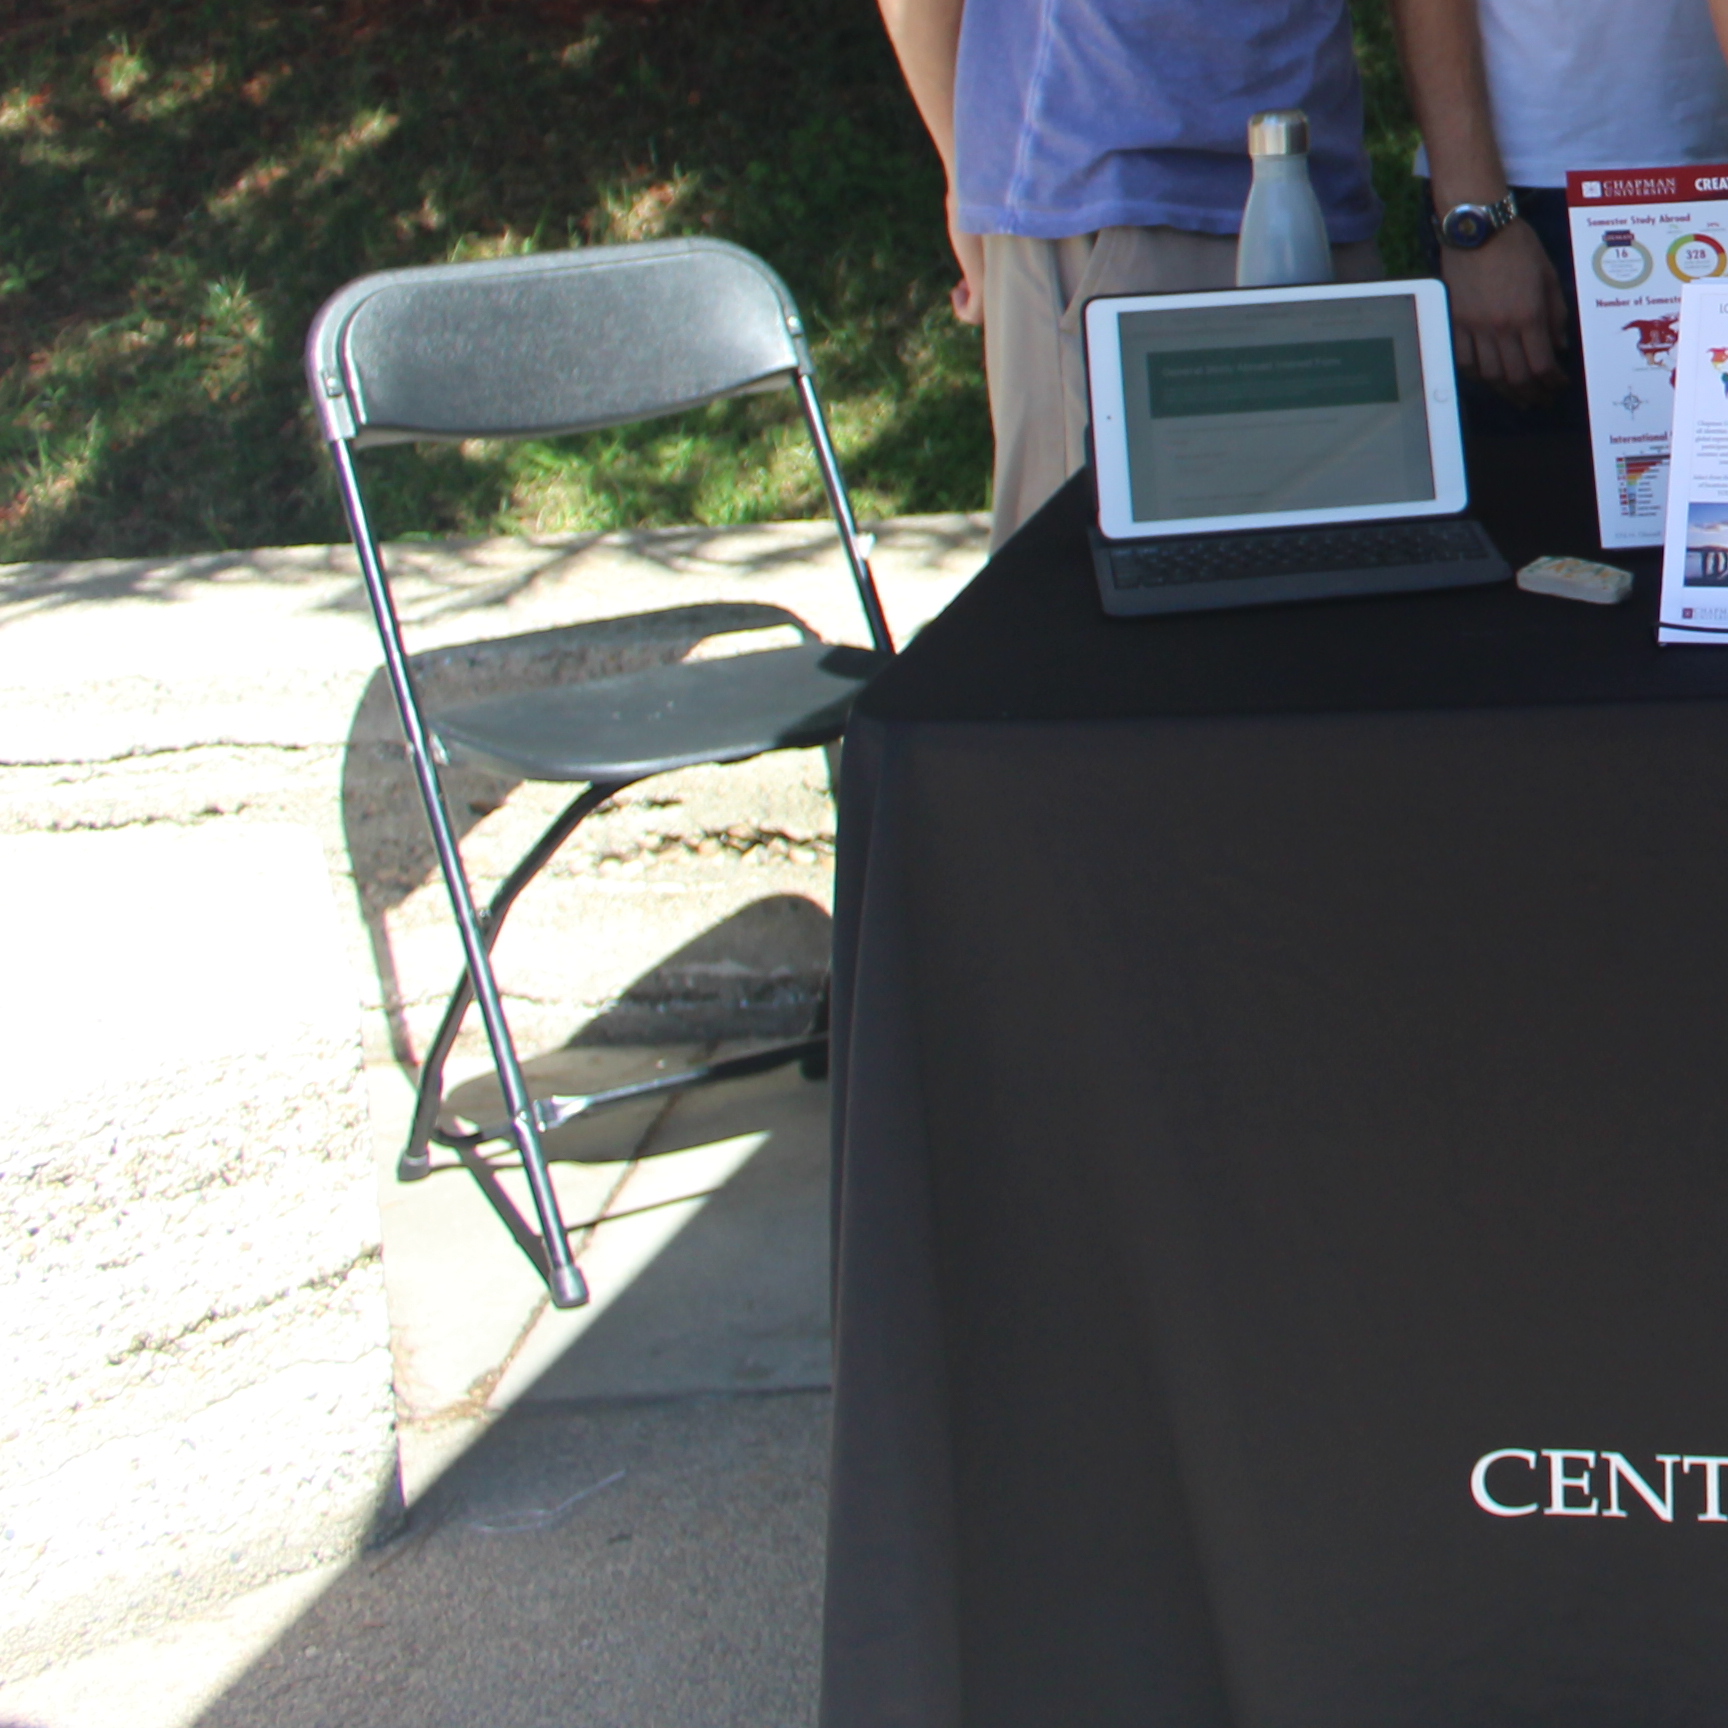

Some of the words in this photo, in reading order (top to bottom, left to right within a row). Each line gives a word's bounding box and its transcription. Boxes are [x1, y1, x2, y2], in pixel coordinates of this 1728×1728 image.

[1603, 177, 1676, 189] CHAPMAN
[1603, 186, 1677, 197] UNIVERSITY
[1587, 216, 1628, 226] Semester
[1631, 215, 1655, 226] Study
[1659, 214, 1691, 223] Abroad
[1615, 249, 1628, 258] 16
[1610, 431, 1668, 444] International
